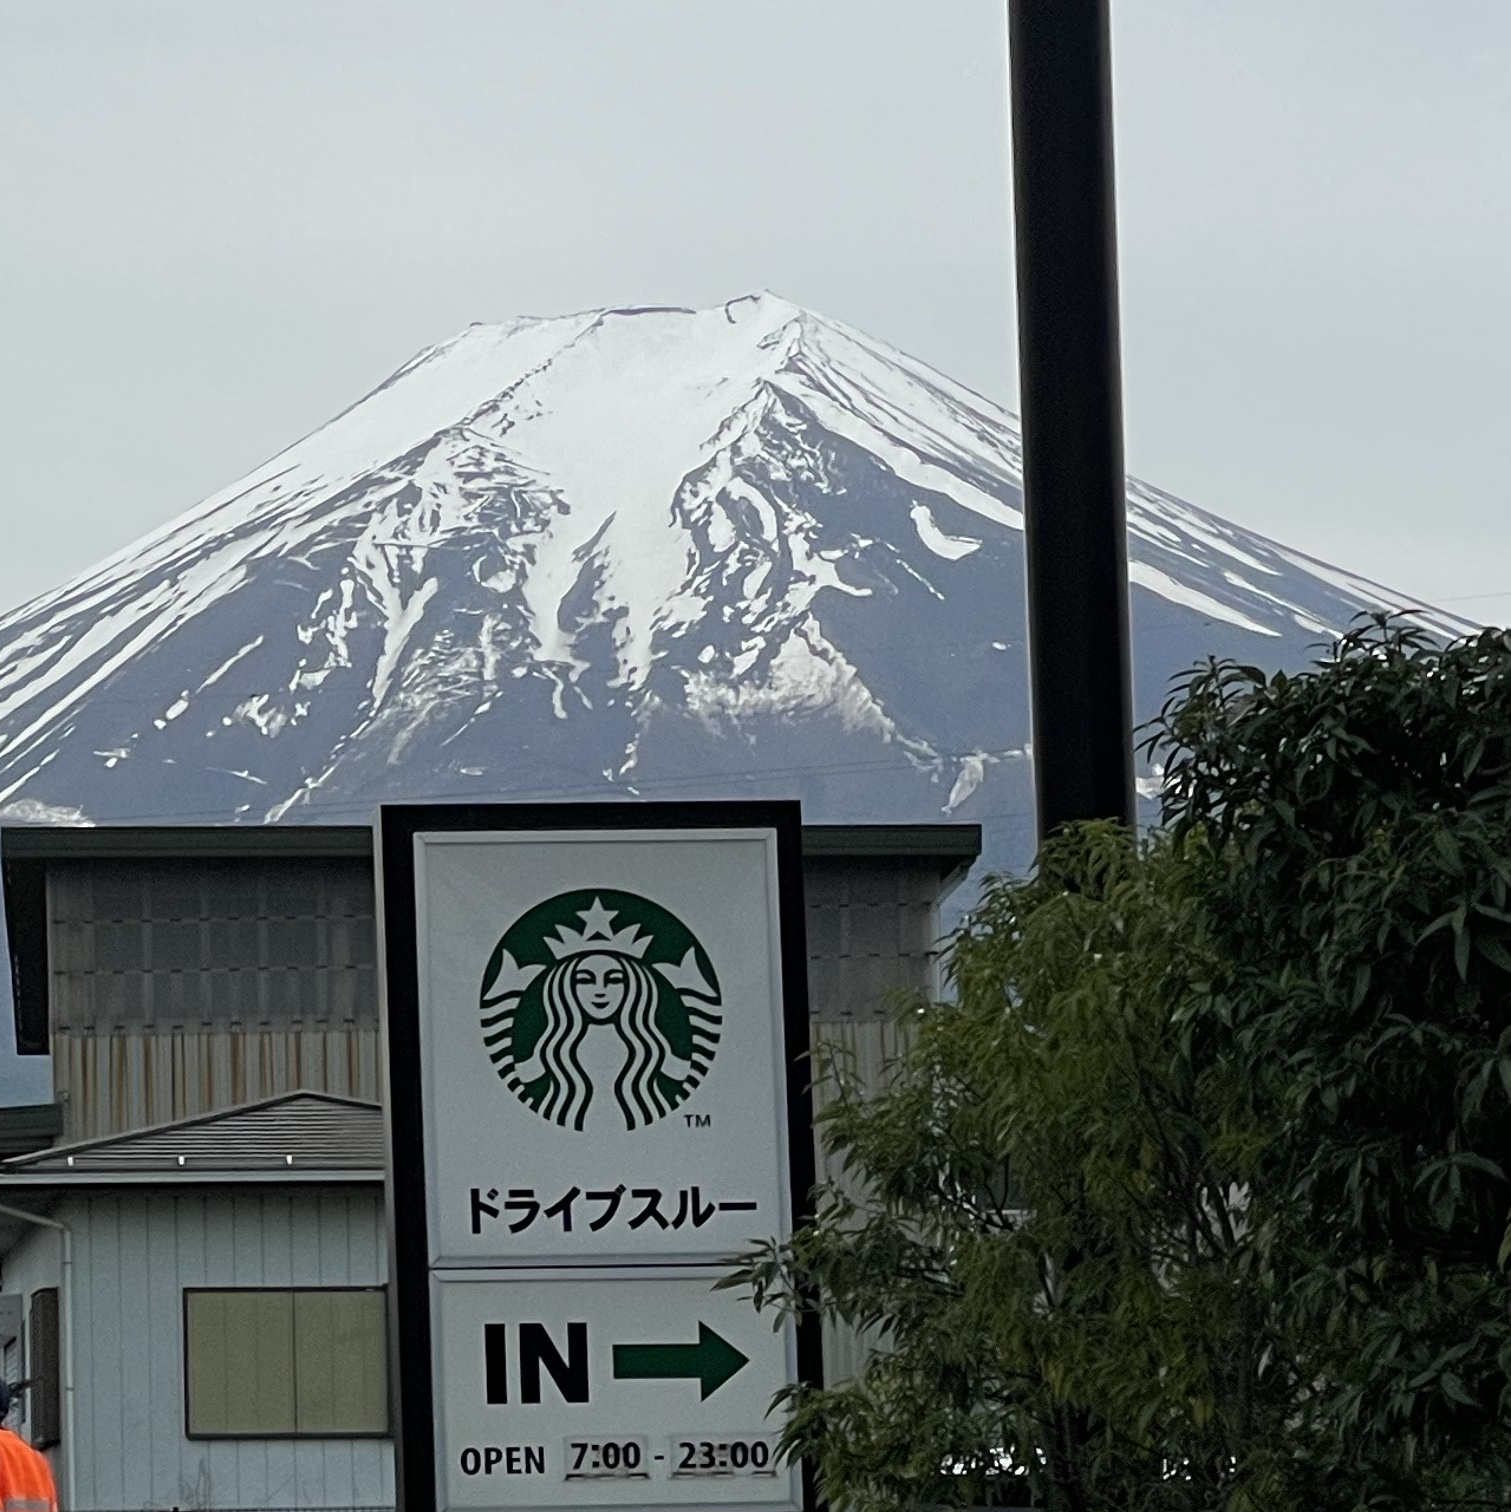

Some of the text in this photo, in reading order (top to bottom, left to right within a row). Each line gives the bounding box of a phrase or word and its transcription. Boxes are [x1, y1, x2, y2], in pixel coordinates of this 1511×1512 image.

[683, 1113, 711, 1128] TM
[469, 1183, 758, 1235] ドライブスルー
[484, 1321, 590, 1405] IN
[460, 1446, 546, 1476] OPEN
[569, 1441, 642, 1471] 7:00
[677, 1441, 771, 1470] 23:00
